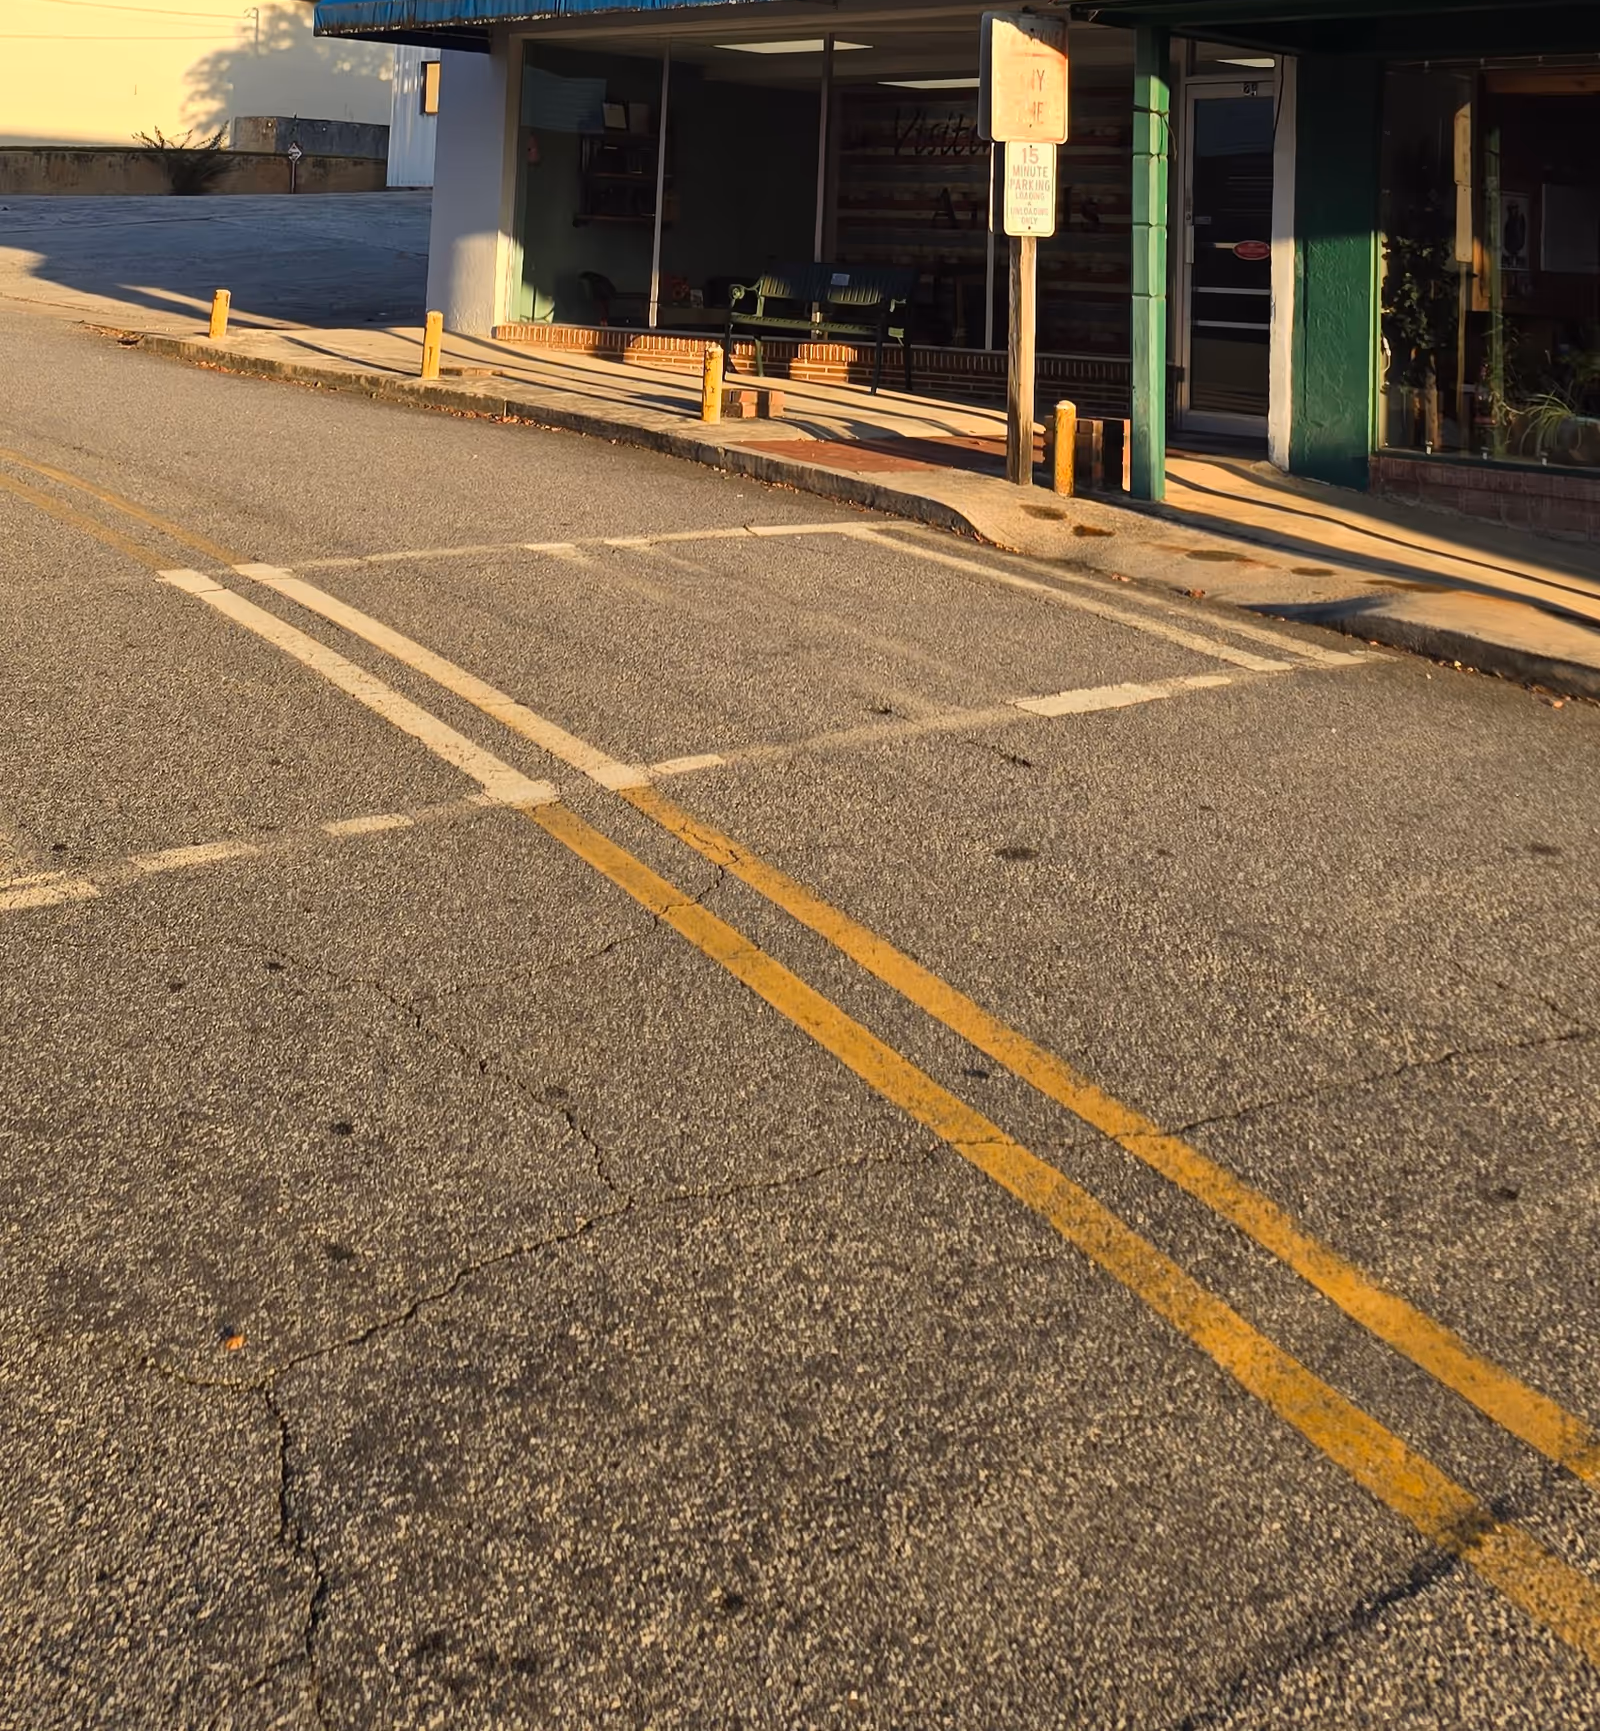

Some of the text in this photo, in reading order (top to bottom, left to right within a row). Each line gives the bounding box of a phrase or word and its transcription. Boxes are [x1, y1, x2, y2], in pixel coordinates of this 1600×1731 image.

[1022, 147, 1040, 164] 15
[1012, 164, 1049, 178] MINUTE
[1010, 178, 1051, 192] PARKING
[1015, 191, 1045, 201] LOADING
[1021, 216, 1038, 225] ONLY
